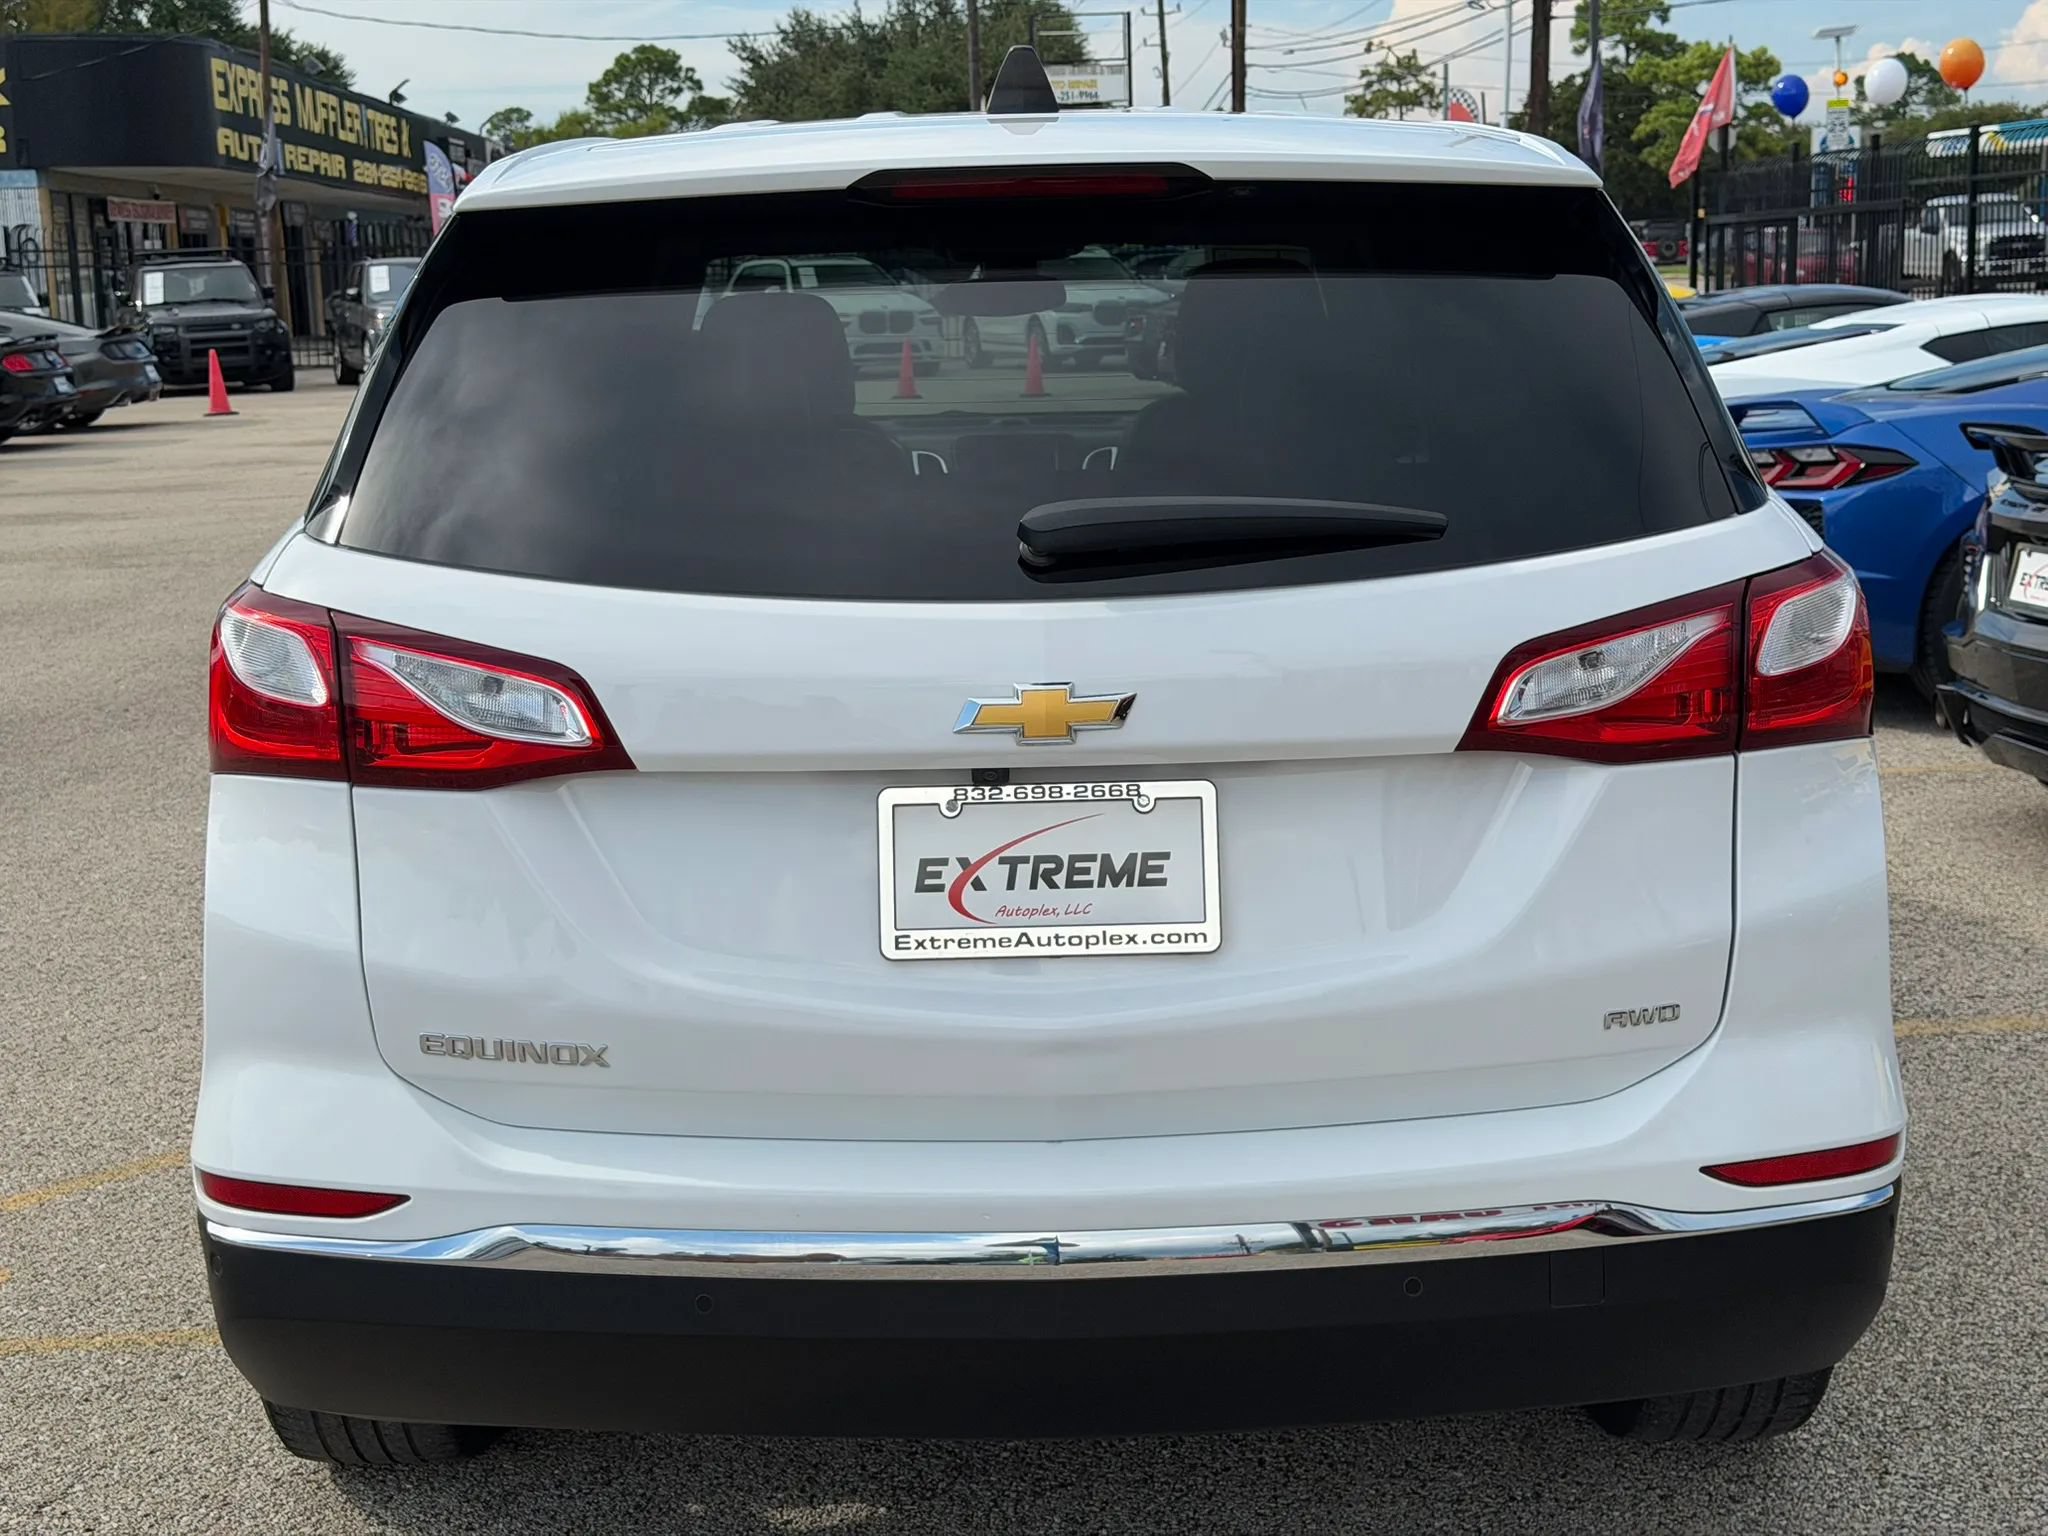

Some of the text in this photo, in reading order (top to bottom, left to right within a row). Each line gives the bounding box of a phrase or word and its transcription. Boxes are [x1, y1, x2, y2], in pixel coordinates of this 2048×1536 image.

[210, 57, 292, 127] EXPRSS
[216, 126, 347, 180] AUT REPAIR
[953, 783, 1142, 801] 832-698-2668
[914, 851, 1171, 893] EXTREME
[995, 903, 1093, 920] Autoplex, LLC
[894, 930, 1208, 951] ExtremeAutoplex.com
[1604, 1004, 1680, 1030] AWD
[419, 1032, 610, 1068] EQUINOX
